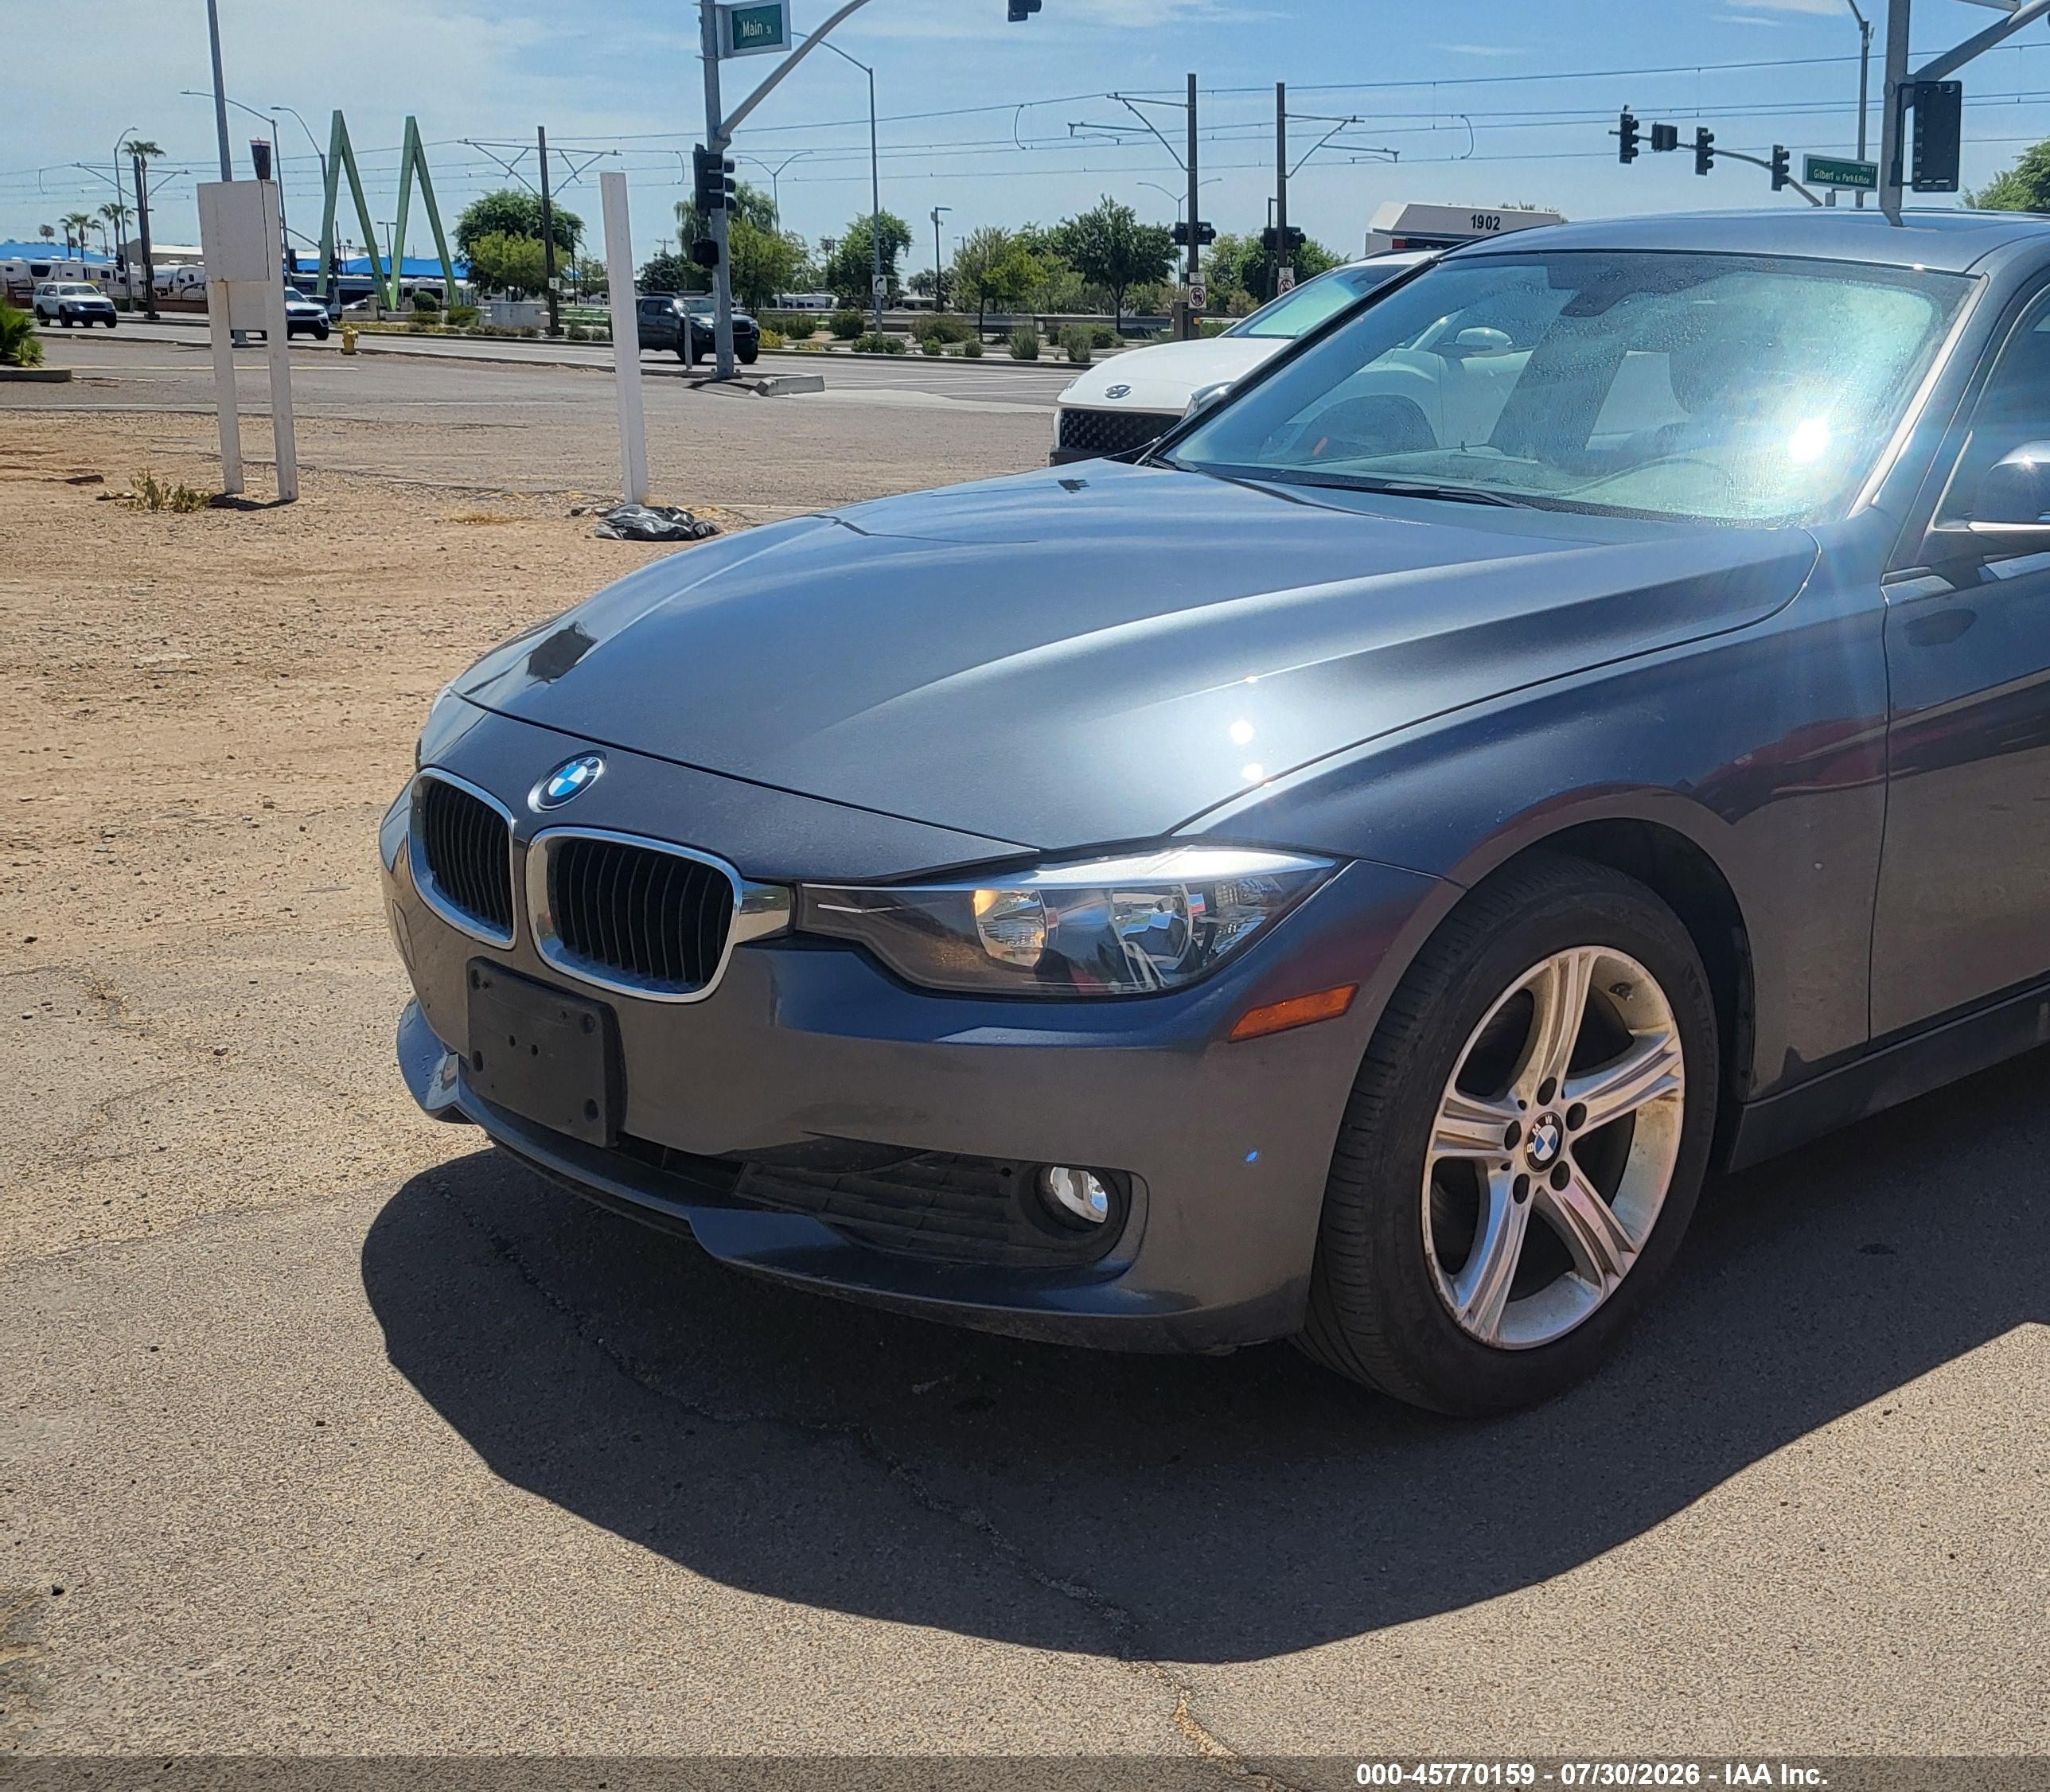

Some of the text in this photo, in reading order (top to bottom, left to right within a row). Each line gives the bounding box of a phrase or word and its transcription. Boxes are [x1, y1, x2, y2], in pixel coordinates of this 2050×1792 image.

[742, 19, 763, 37] Main
[1814, 169, 1834, 181] Gilbert
[1471, 214, 1500, 231] 1902
[1526, 1114, 1553, 1153] BMW
